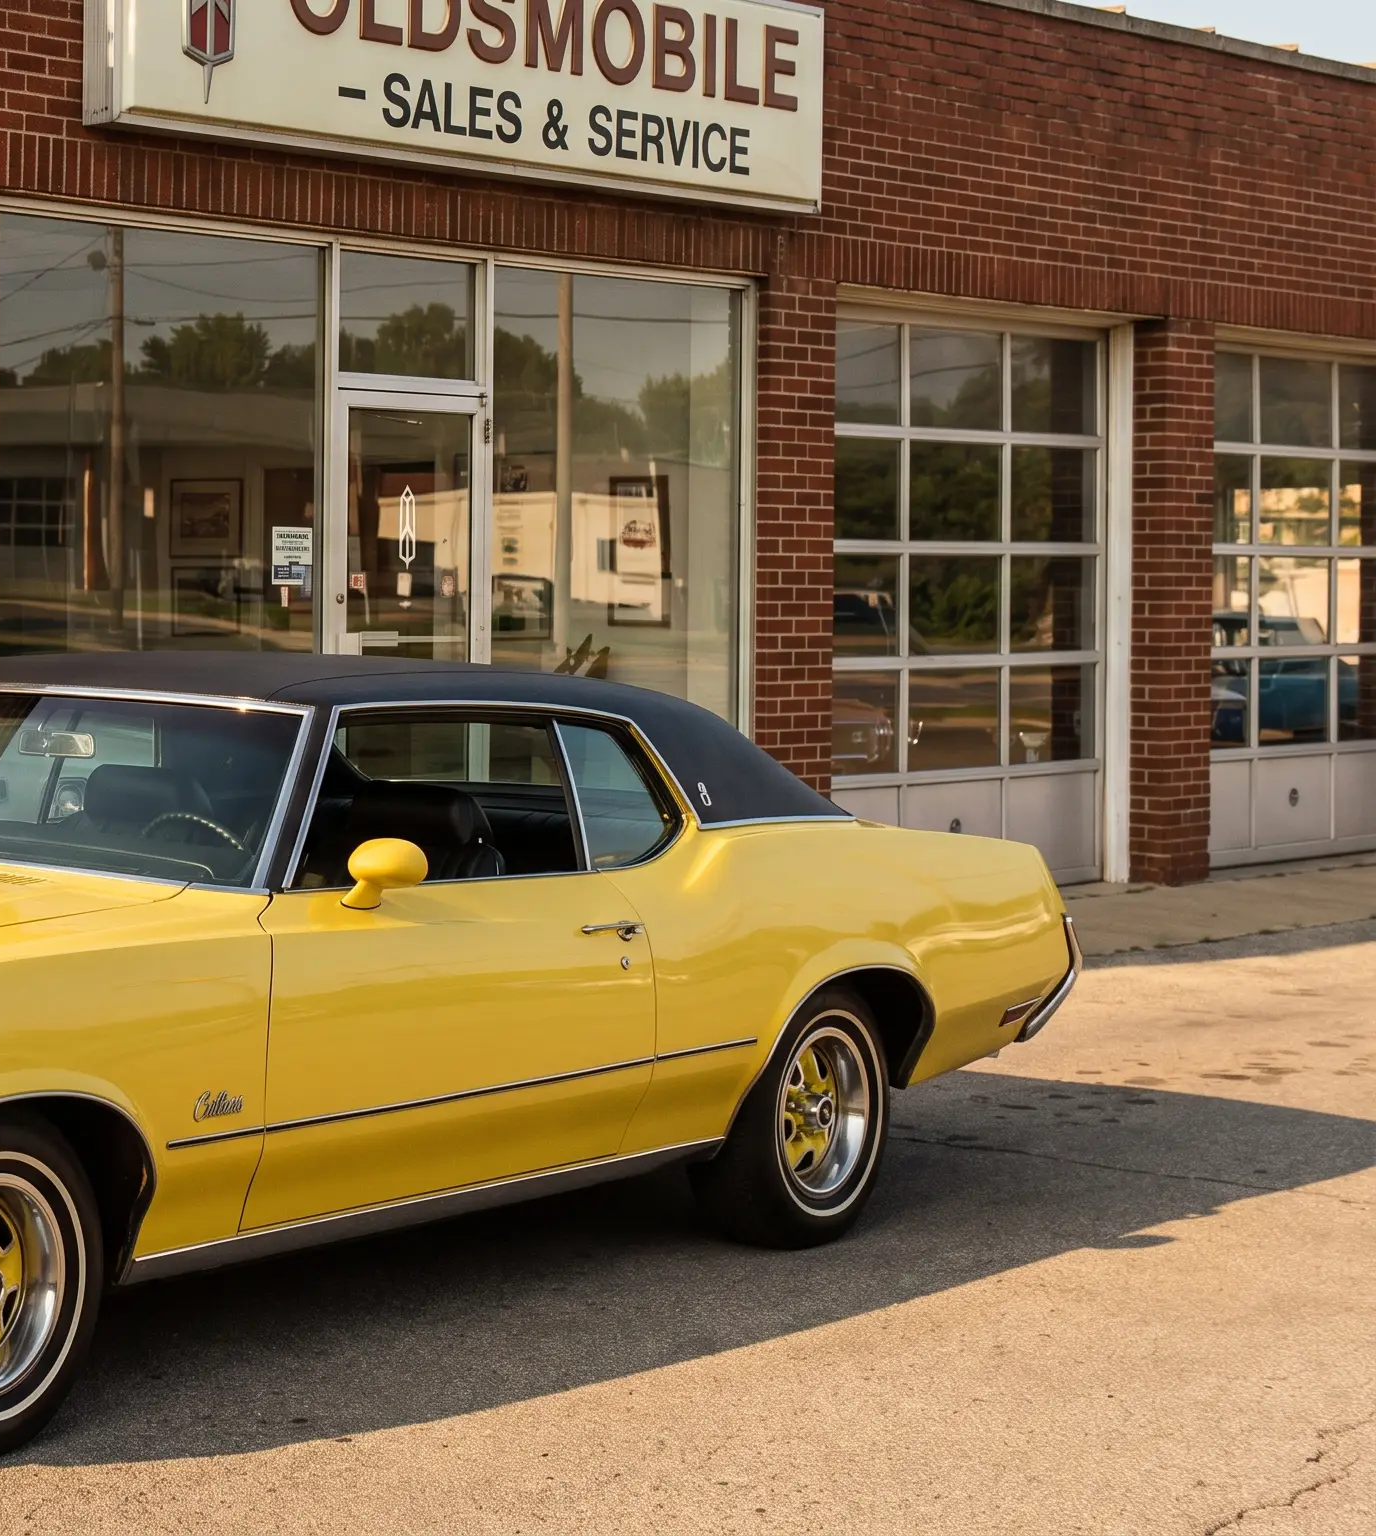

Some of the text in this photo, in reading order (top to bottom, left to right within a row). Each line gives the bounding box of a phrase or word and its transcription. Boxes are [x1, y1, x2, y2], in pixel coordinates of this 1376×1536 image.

[381, 72, 523, 144] SALES
[541, 98, 570, 151] &
[587, 104, 751, 176] SERVICE
